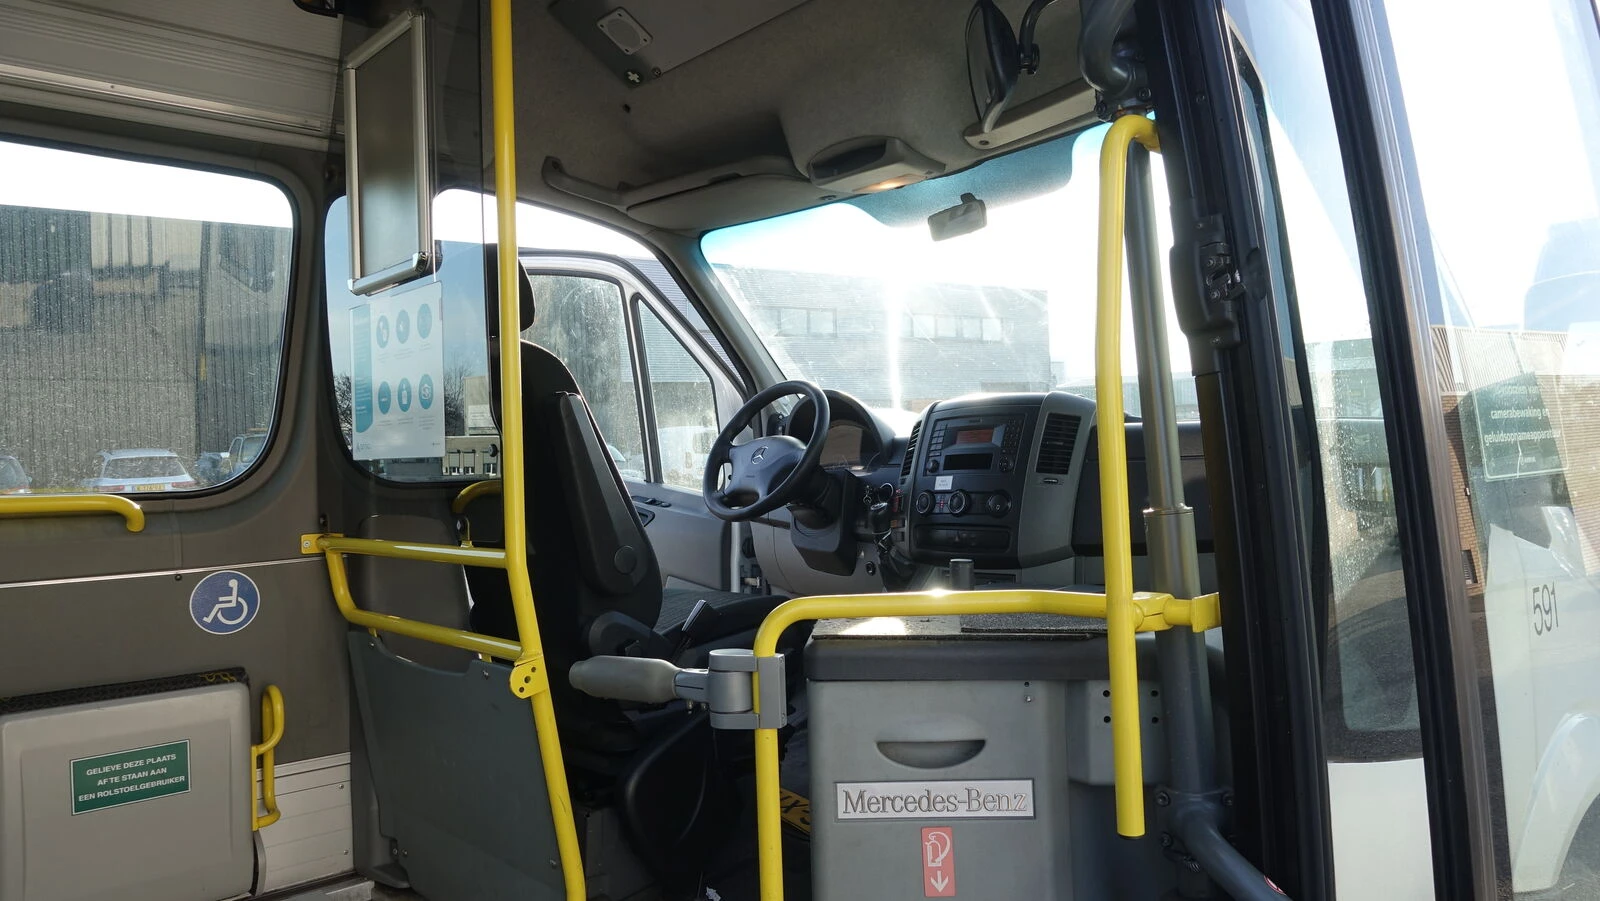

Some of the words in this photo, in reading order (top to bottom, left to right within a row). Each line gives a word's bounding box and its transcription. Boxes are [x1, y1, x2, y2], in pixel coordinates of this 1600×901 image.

[1490, 407, 1541, 419] camerabewaking
[1532, 581, 1559, 635] 591
[86, 763, 122, 776] GELIEVE
[123, 759, 145, 770] DEZE
[146, 753, 177, 765] PLAATS
[97, 778, 109, 786] AF
[109, 776, 120, 784] TE
[121, 770, 148, 782] STAAN
[150, 767, 167, 776] AAN
[78, 792, 96, 802] EEN
[97, 775, 185, 798] ROLSTOELGEBRUIKER
[842, 787, 1028, 814] Mercedes-Benz
